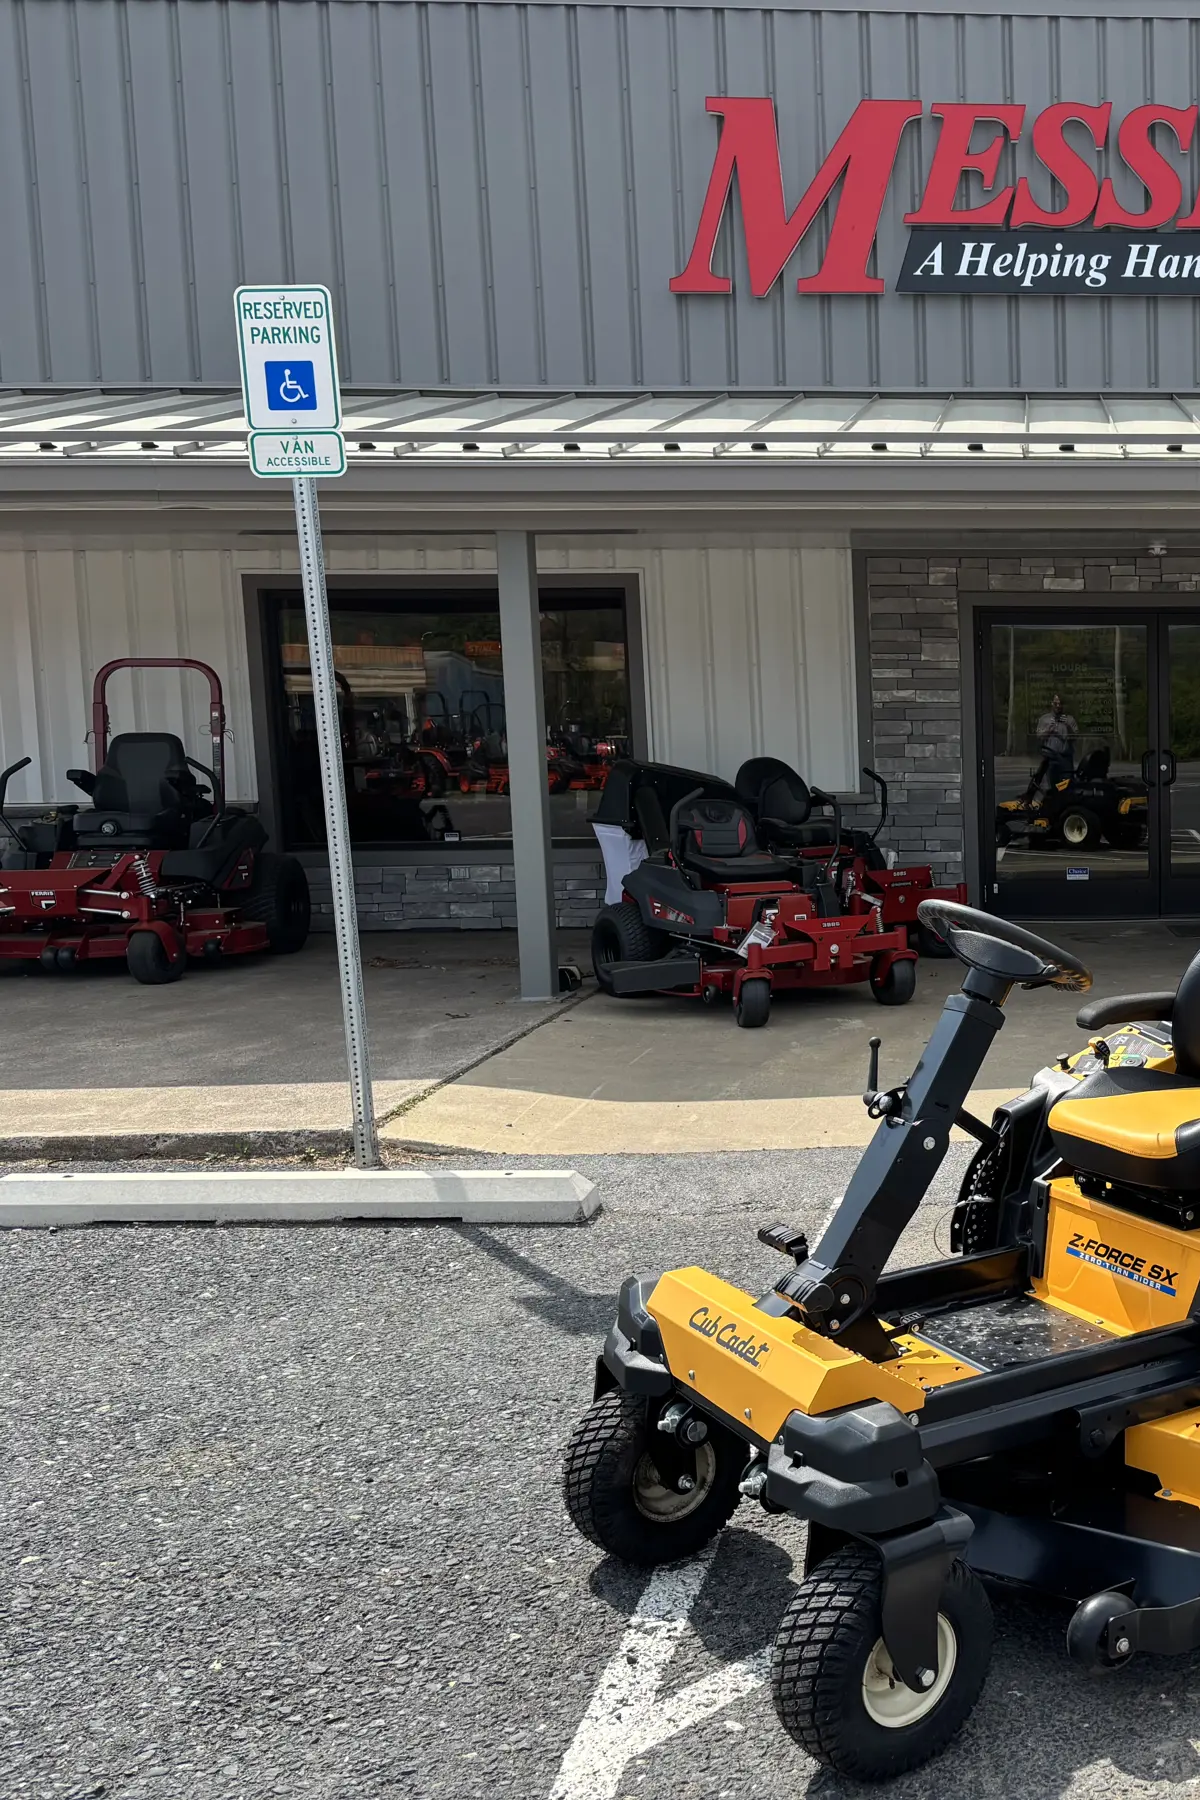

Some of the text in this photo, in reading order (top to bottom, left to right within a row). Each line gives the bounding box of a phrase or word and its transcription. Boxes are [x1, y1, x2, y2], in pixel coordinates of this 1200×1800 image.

[913, 242, 945, 276] A
[955, 243, 1112, 287] Helping
[242, 301, 324, 320] RESERVED
[250, 326, 321, 344] PARKING
[280, 440, 315, 454] VAN
[266, 456, 331, 467] ACCESSIBLE
[1132, 1273, 1161, 1290] RIDER
[1147, 1264, 1179, 1286] SX
[689, 1306, 769, 1368] Cub Cadet
